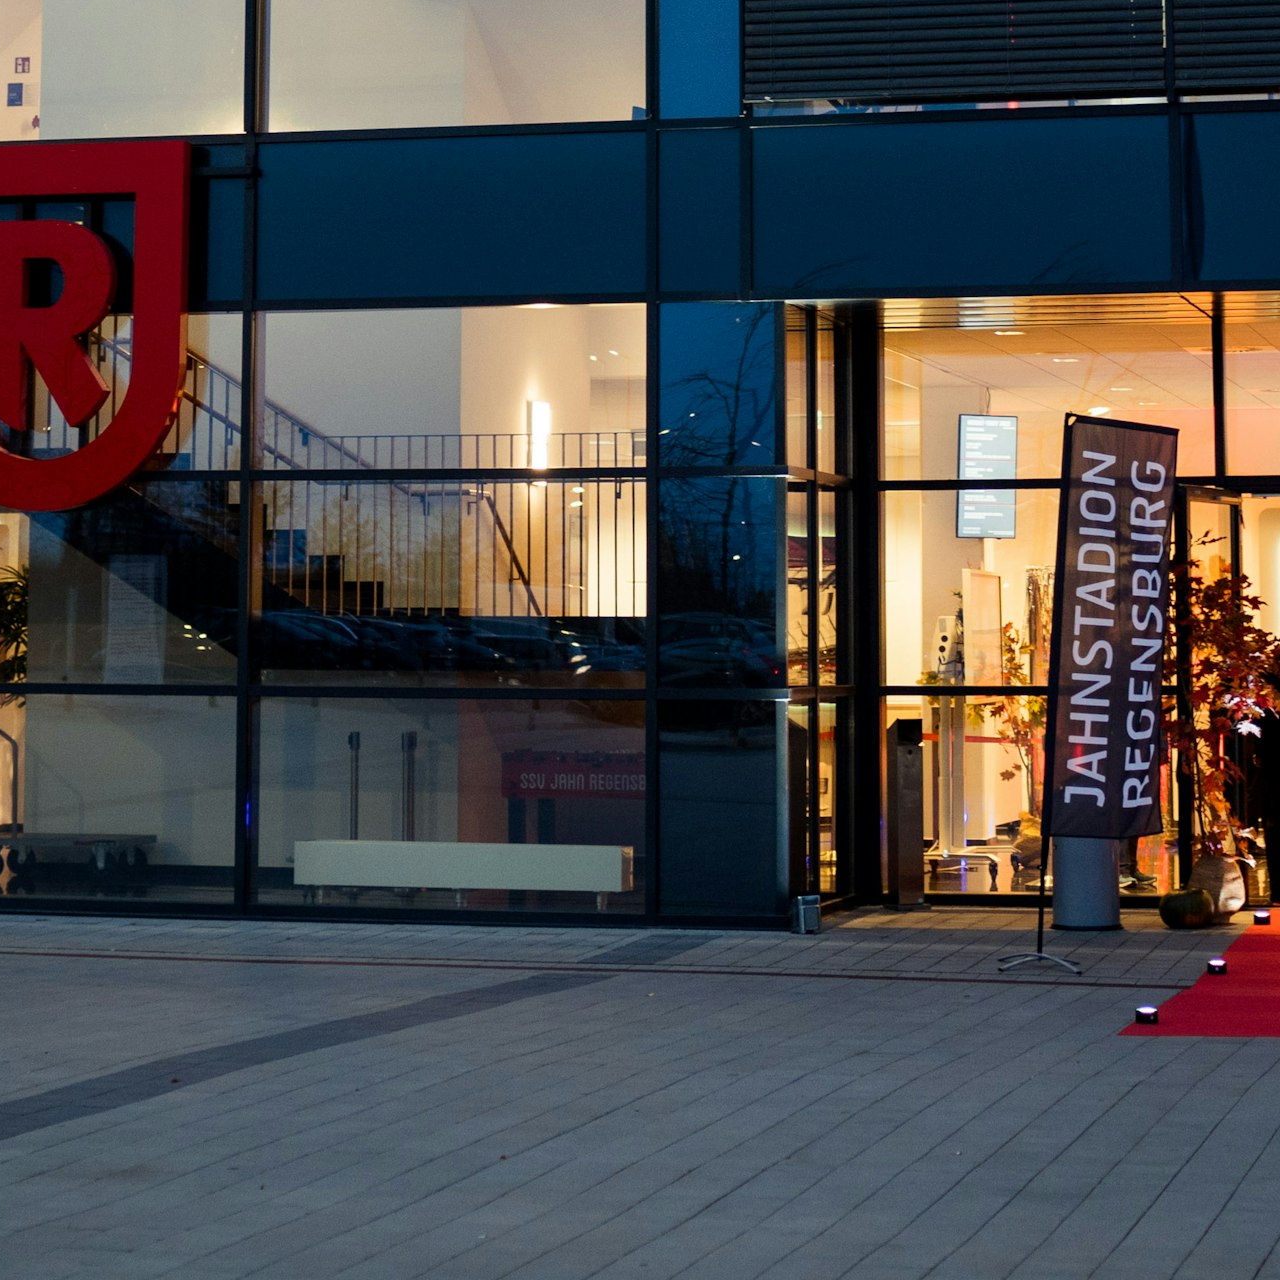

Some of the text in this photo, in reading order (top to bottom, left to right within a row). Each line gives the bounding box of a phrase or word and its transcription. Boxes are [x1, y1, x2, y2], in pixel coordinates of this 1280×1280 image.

[519, 772, 546, 790] SSV
[549, 773, 586, 791] JAHN
[1064, 449, 1117, 808] JAHNSTADION
[1122, 459, 1167, 810] REGENSBURG
